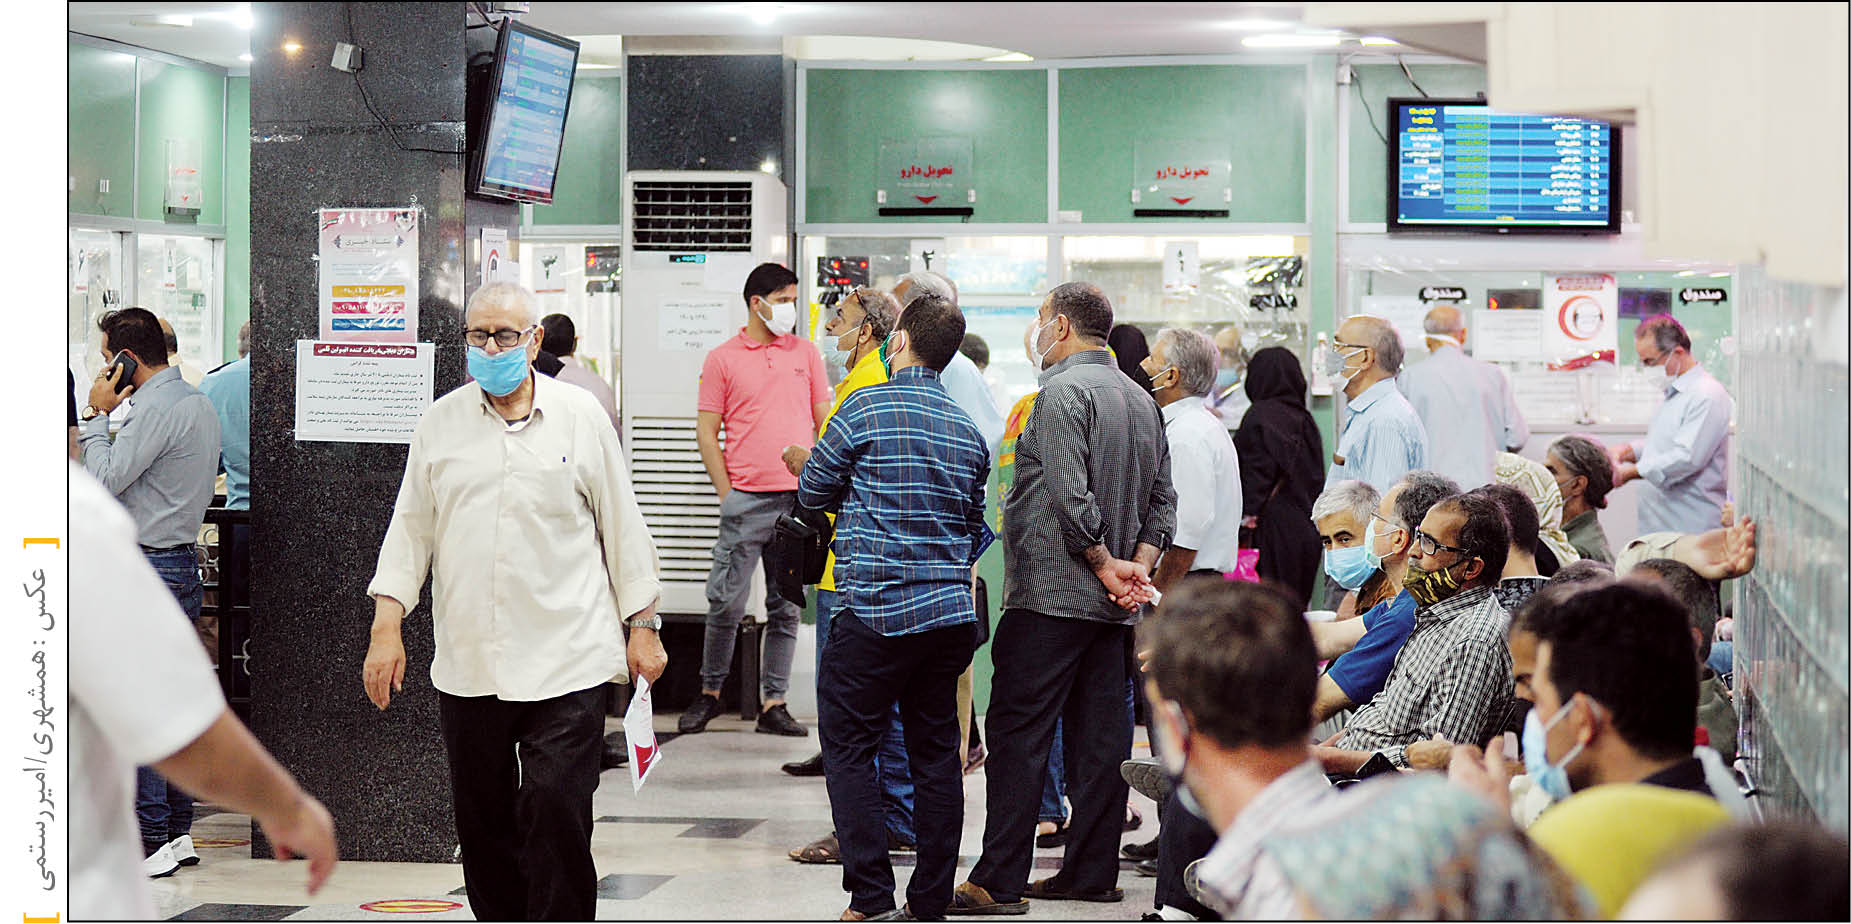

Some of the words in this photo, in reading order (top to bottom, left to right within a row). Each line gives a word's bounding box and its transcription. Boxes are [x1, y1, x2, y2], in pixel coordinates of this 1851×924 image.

[900, 164, 922, 179] دارو
[923, 164, 953, 179] تحویل
[1156, 165, 1177, 180] دارو
[1179, 165, 1209, 180] تحویل
